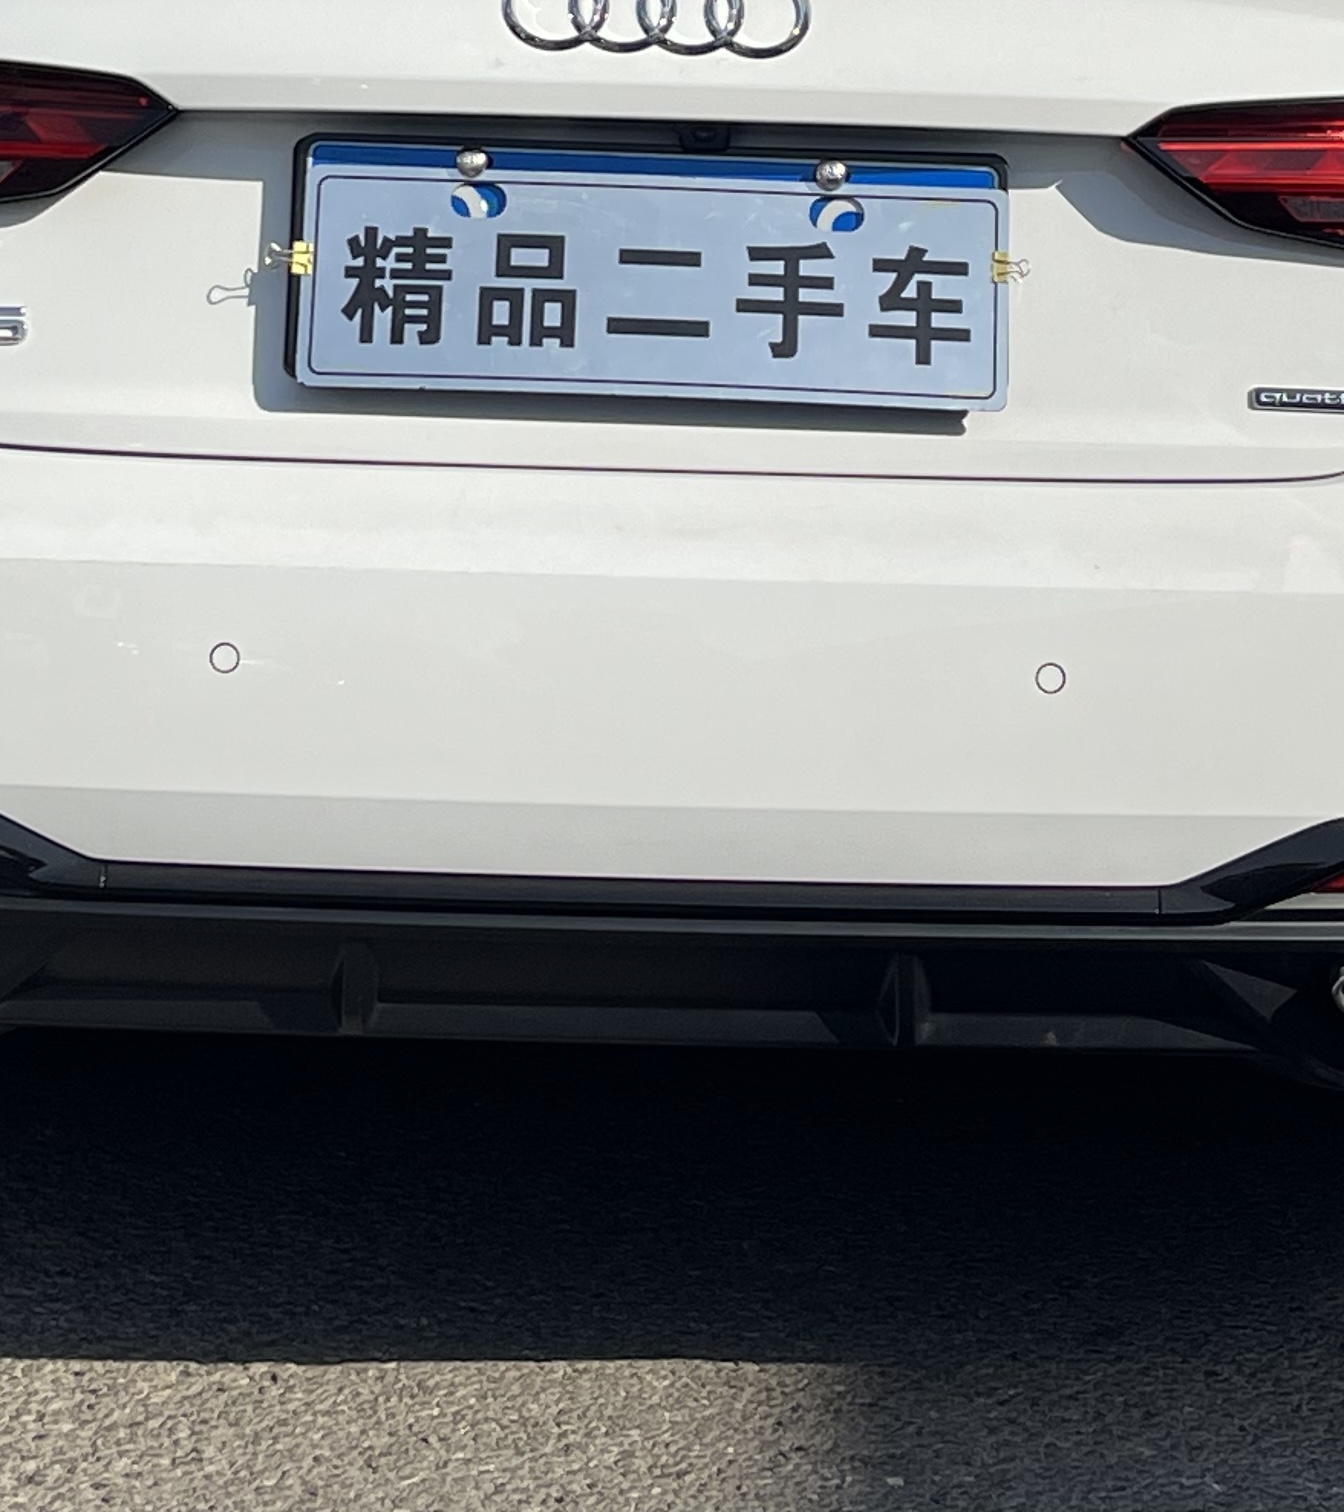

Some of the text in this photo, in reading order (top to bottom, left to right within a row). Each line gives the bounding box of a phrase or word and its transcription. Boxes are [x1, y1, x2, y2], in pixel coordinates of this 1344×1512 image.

[340, 225, 972, 367] 精品二手车
